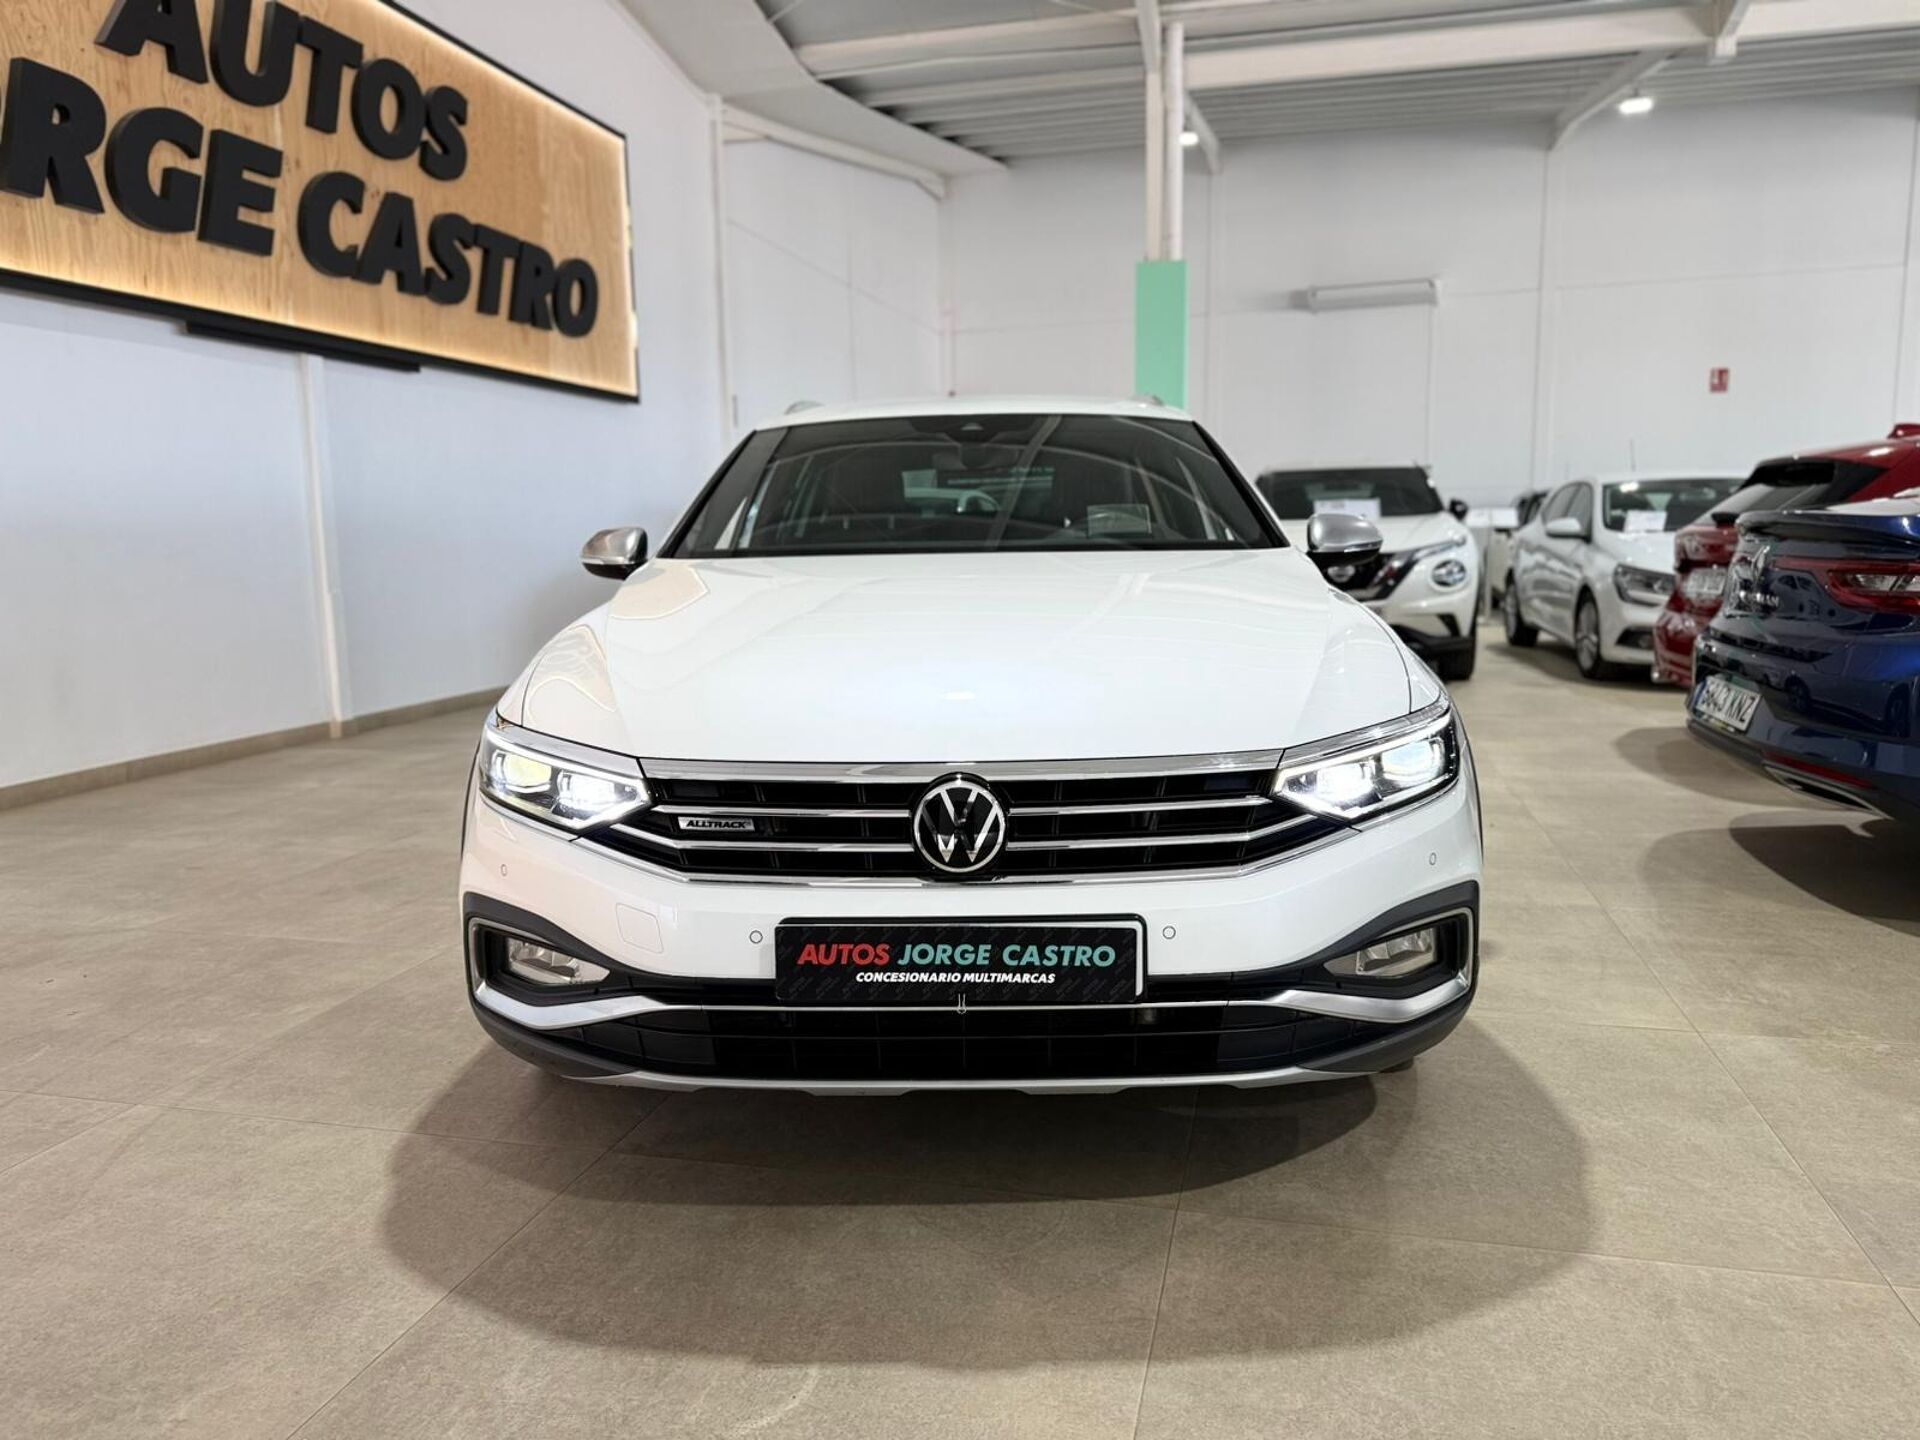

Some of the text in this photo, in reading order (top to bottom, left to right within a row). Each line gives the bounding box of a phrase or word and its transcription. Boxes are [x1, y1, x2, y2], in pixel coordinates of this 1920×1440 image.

[95, 0, 467, 181] AUTOS
[297, 172, 598, 337] CASTRO
[686, 819, 746, 829] ALLTRACK
[797, 943, 1116, 967] AUTOS JORGE CASTRO
[855, 972, 1056, 984] CONCESIONARIO MULTIMARCAS
